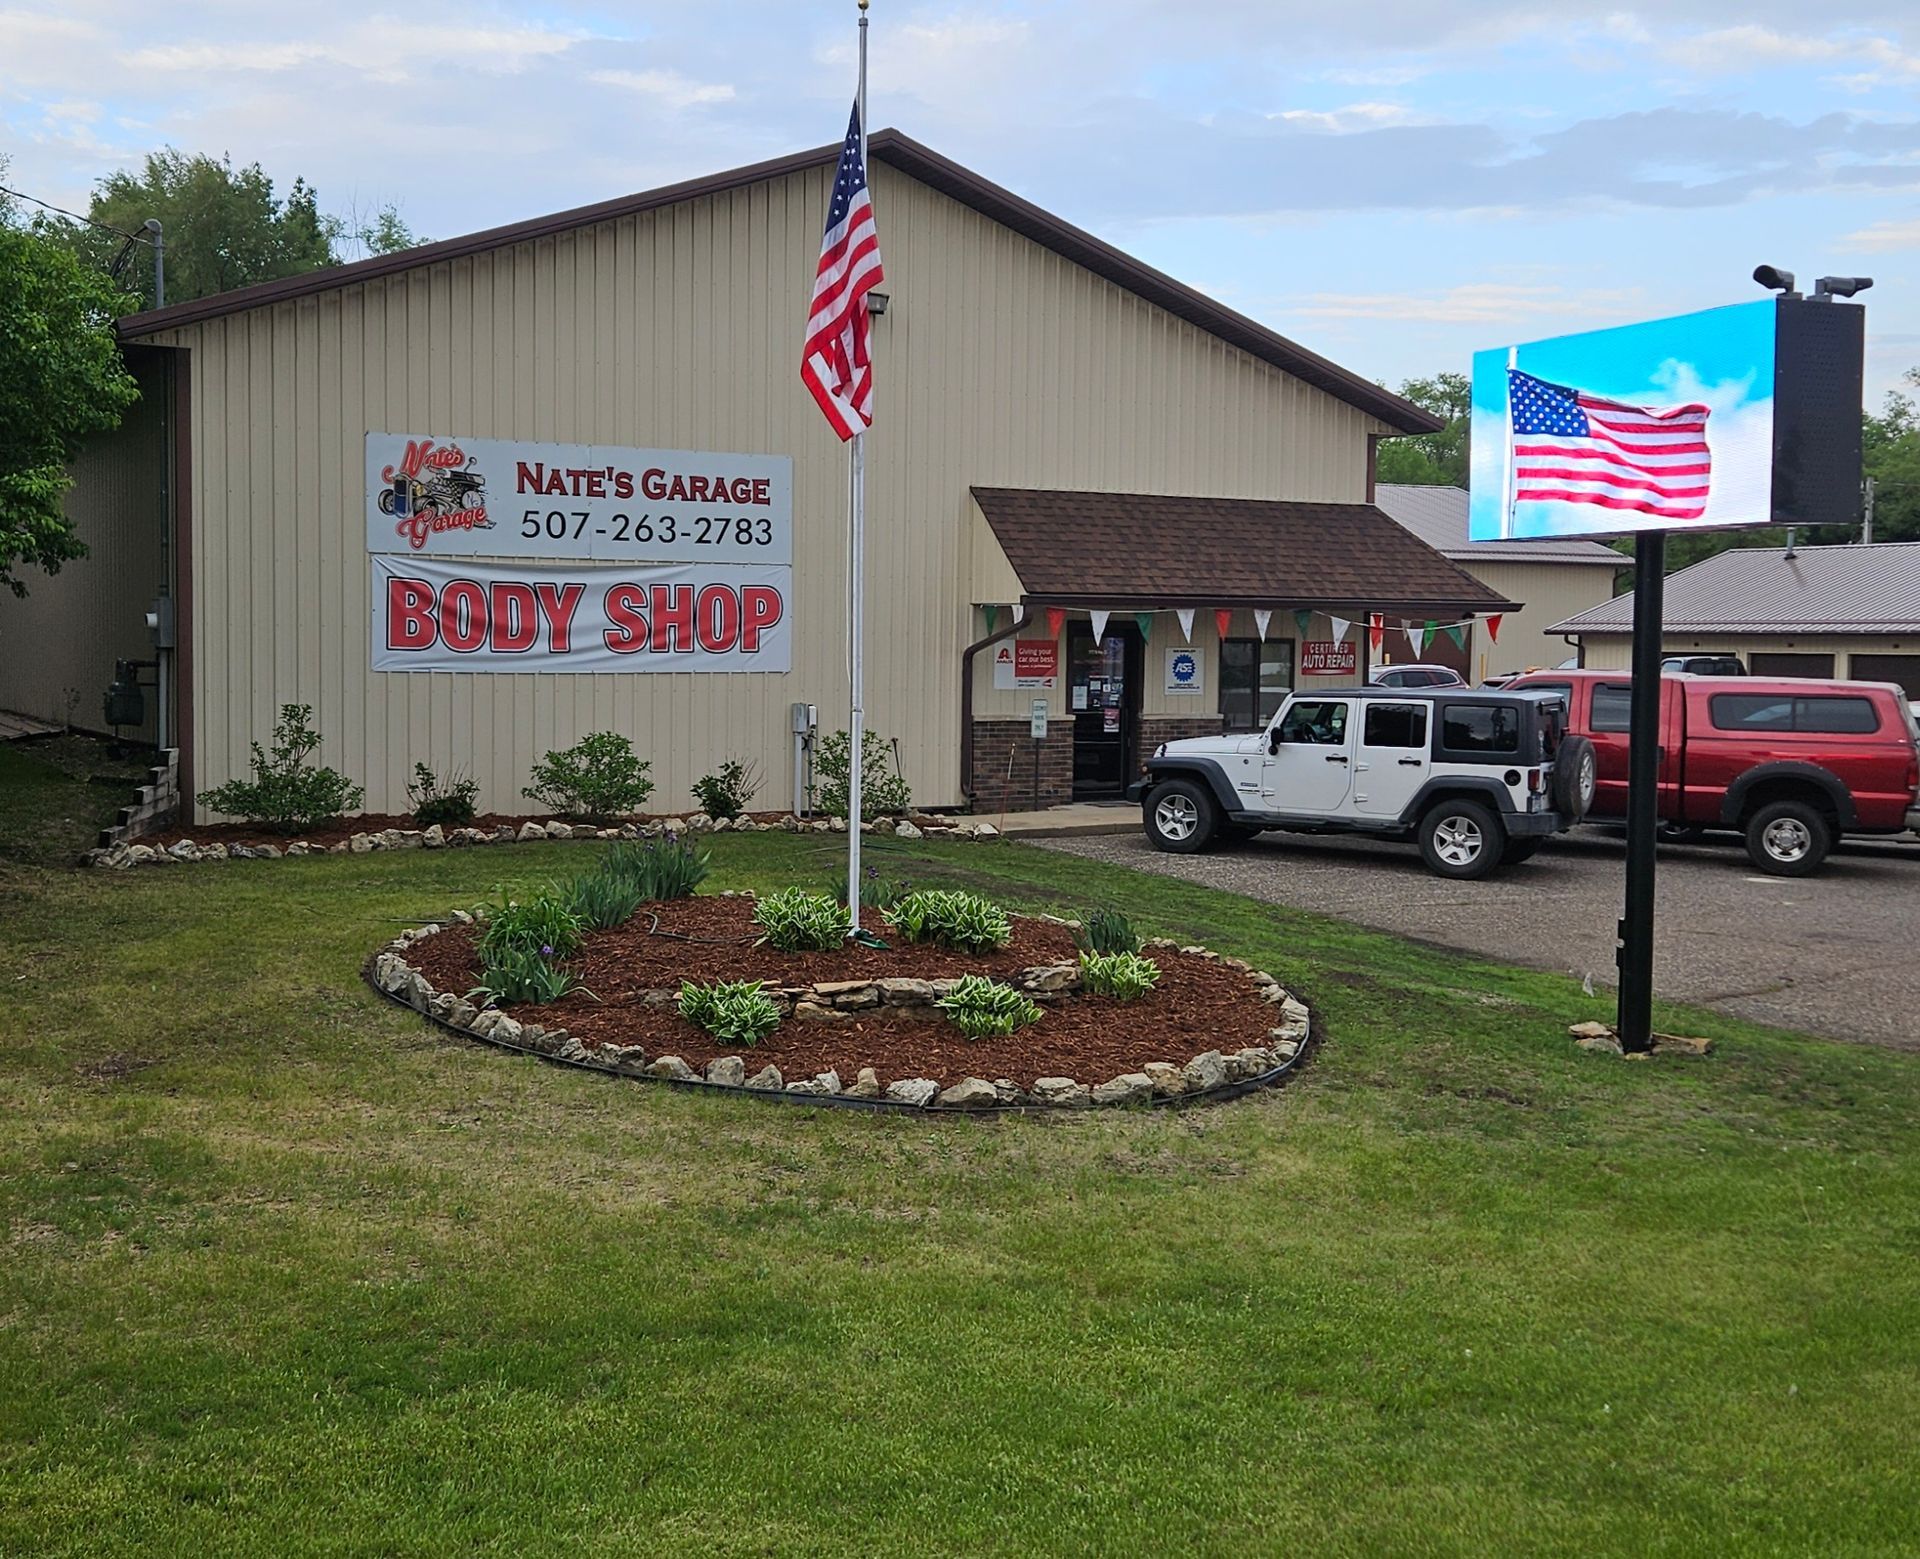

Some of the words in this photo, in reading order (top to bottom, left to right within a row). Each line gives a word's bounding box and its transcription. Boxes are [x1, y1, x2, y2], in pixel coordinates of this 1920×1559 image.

[641, 468, 771, 506] GARAGE
[395, 506, 488, 550] Garage
[520, 510, 773, 546] 507-263-2783
[386, 576, 587, 653] BODY
[603, 582, 783, 653] SHOP
[1303, 655, 1325, 668] AUTO
[1326, 655, 1354, 668] REPAIR
[1310, 644, 1348, 653] CERTIFED
[1175, 663, 1192, 672] ASE
